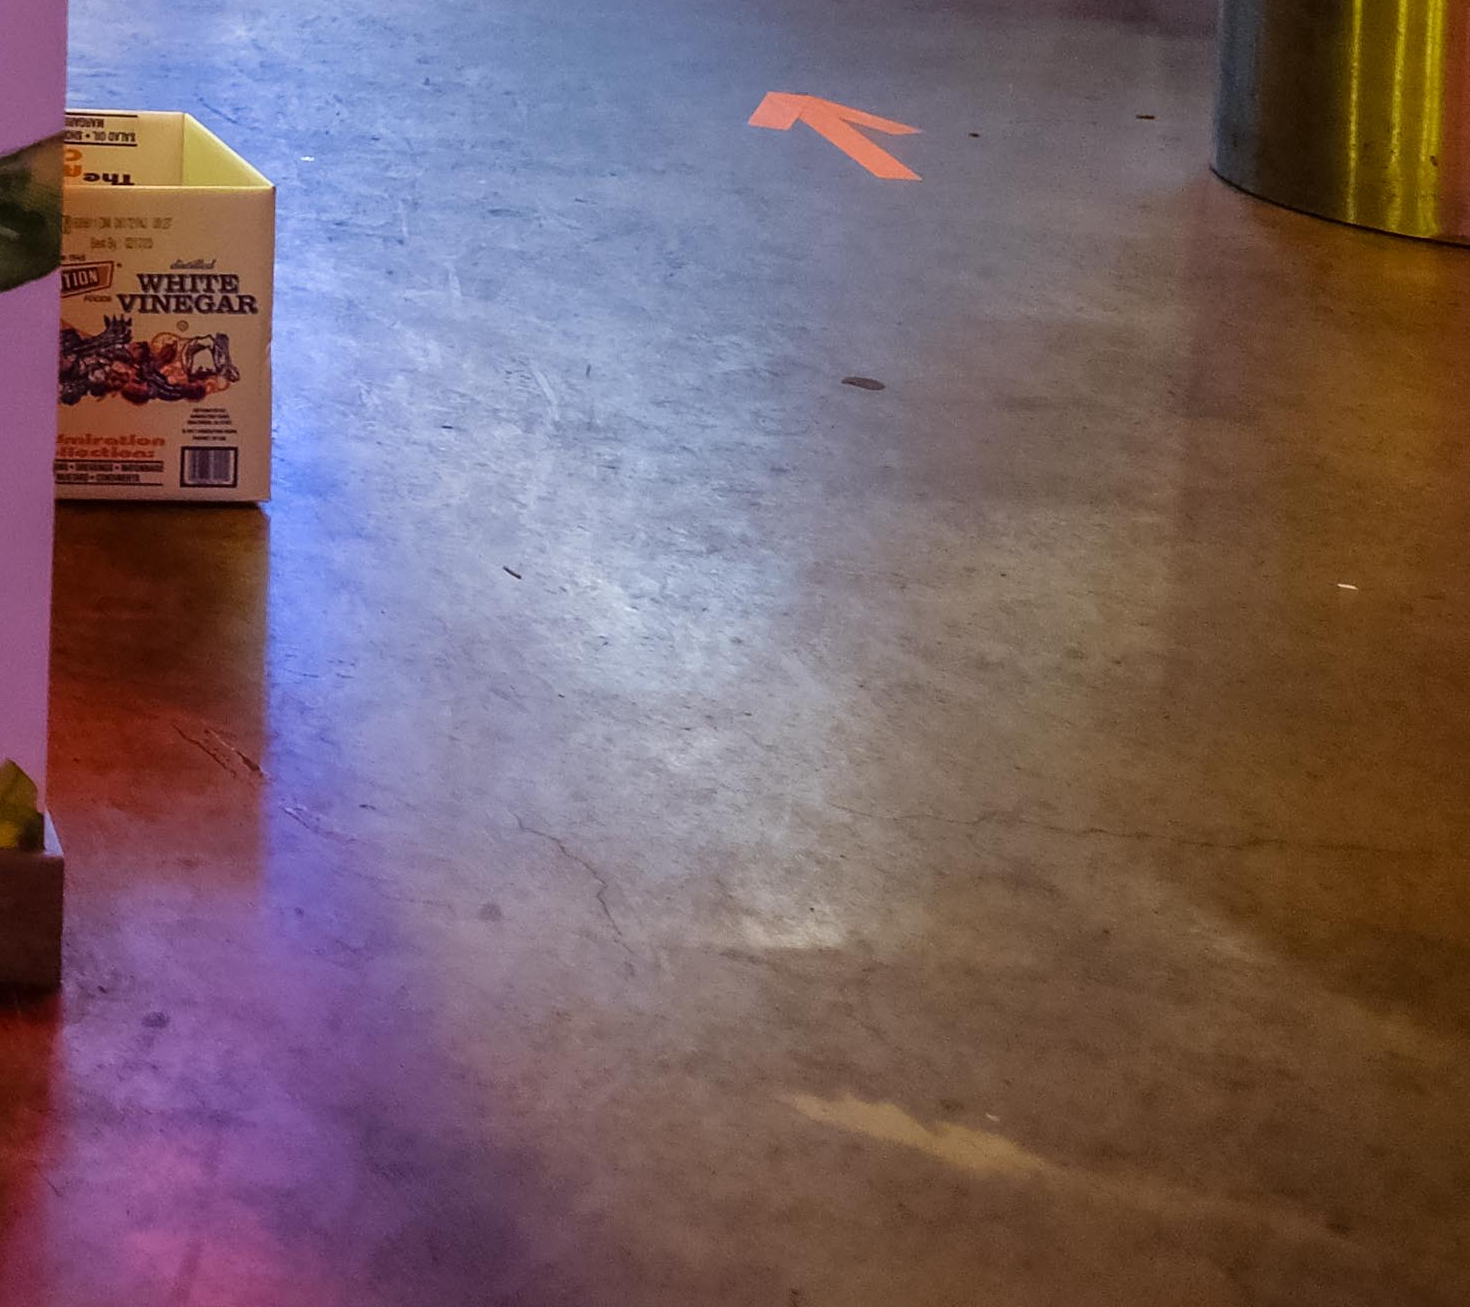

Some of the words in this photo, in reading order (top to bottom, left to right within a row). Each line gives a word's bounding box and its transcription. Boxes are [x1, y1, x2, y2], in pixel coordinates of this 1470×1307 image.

[83, 172, 135, 186] The
[169, 258, 218, 270] distilled
[62, 269, 99, 292] TION
[136, 273, 240, 294] WHITE
[115, 294, 259, 315] VINEGAR
